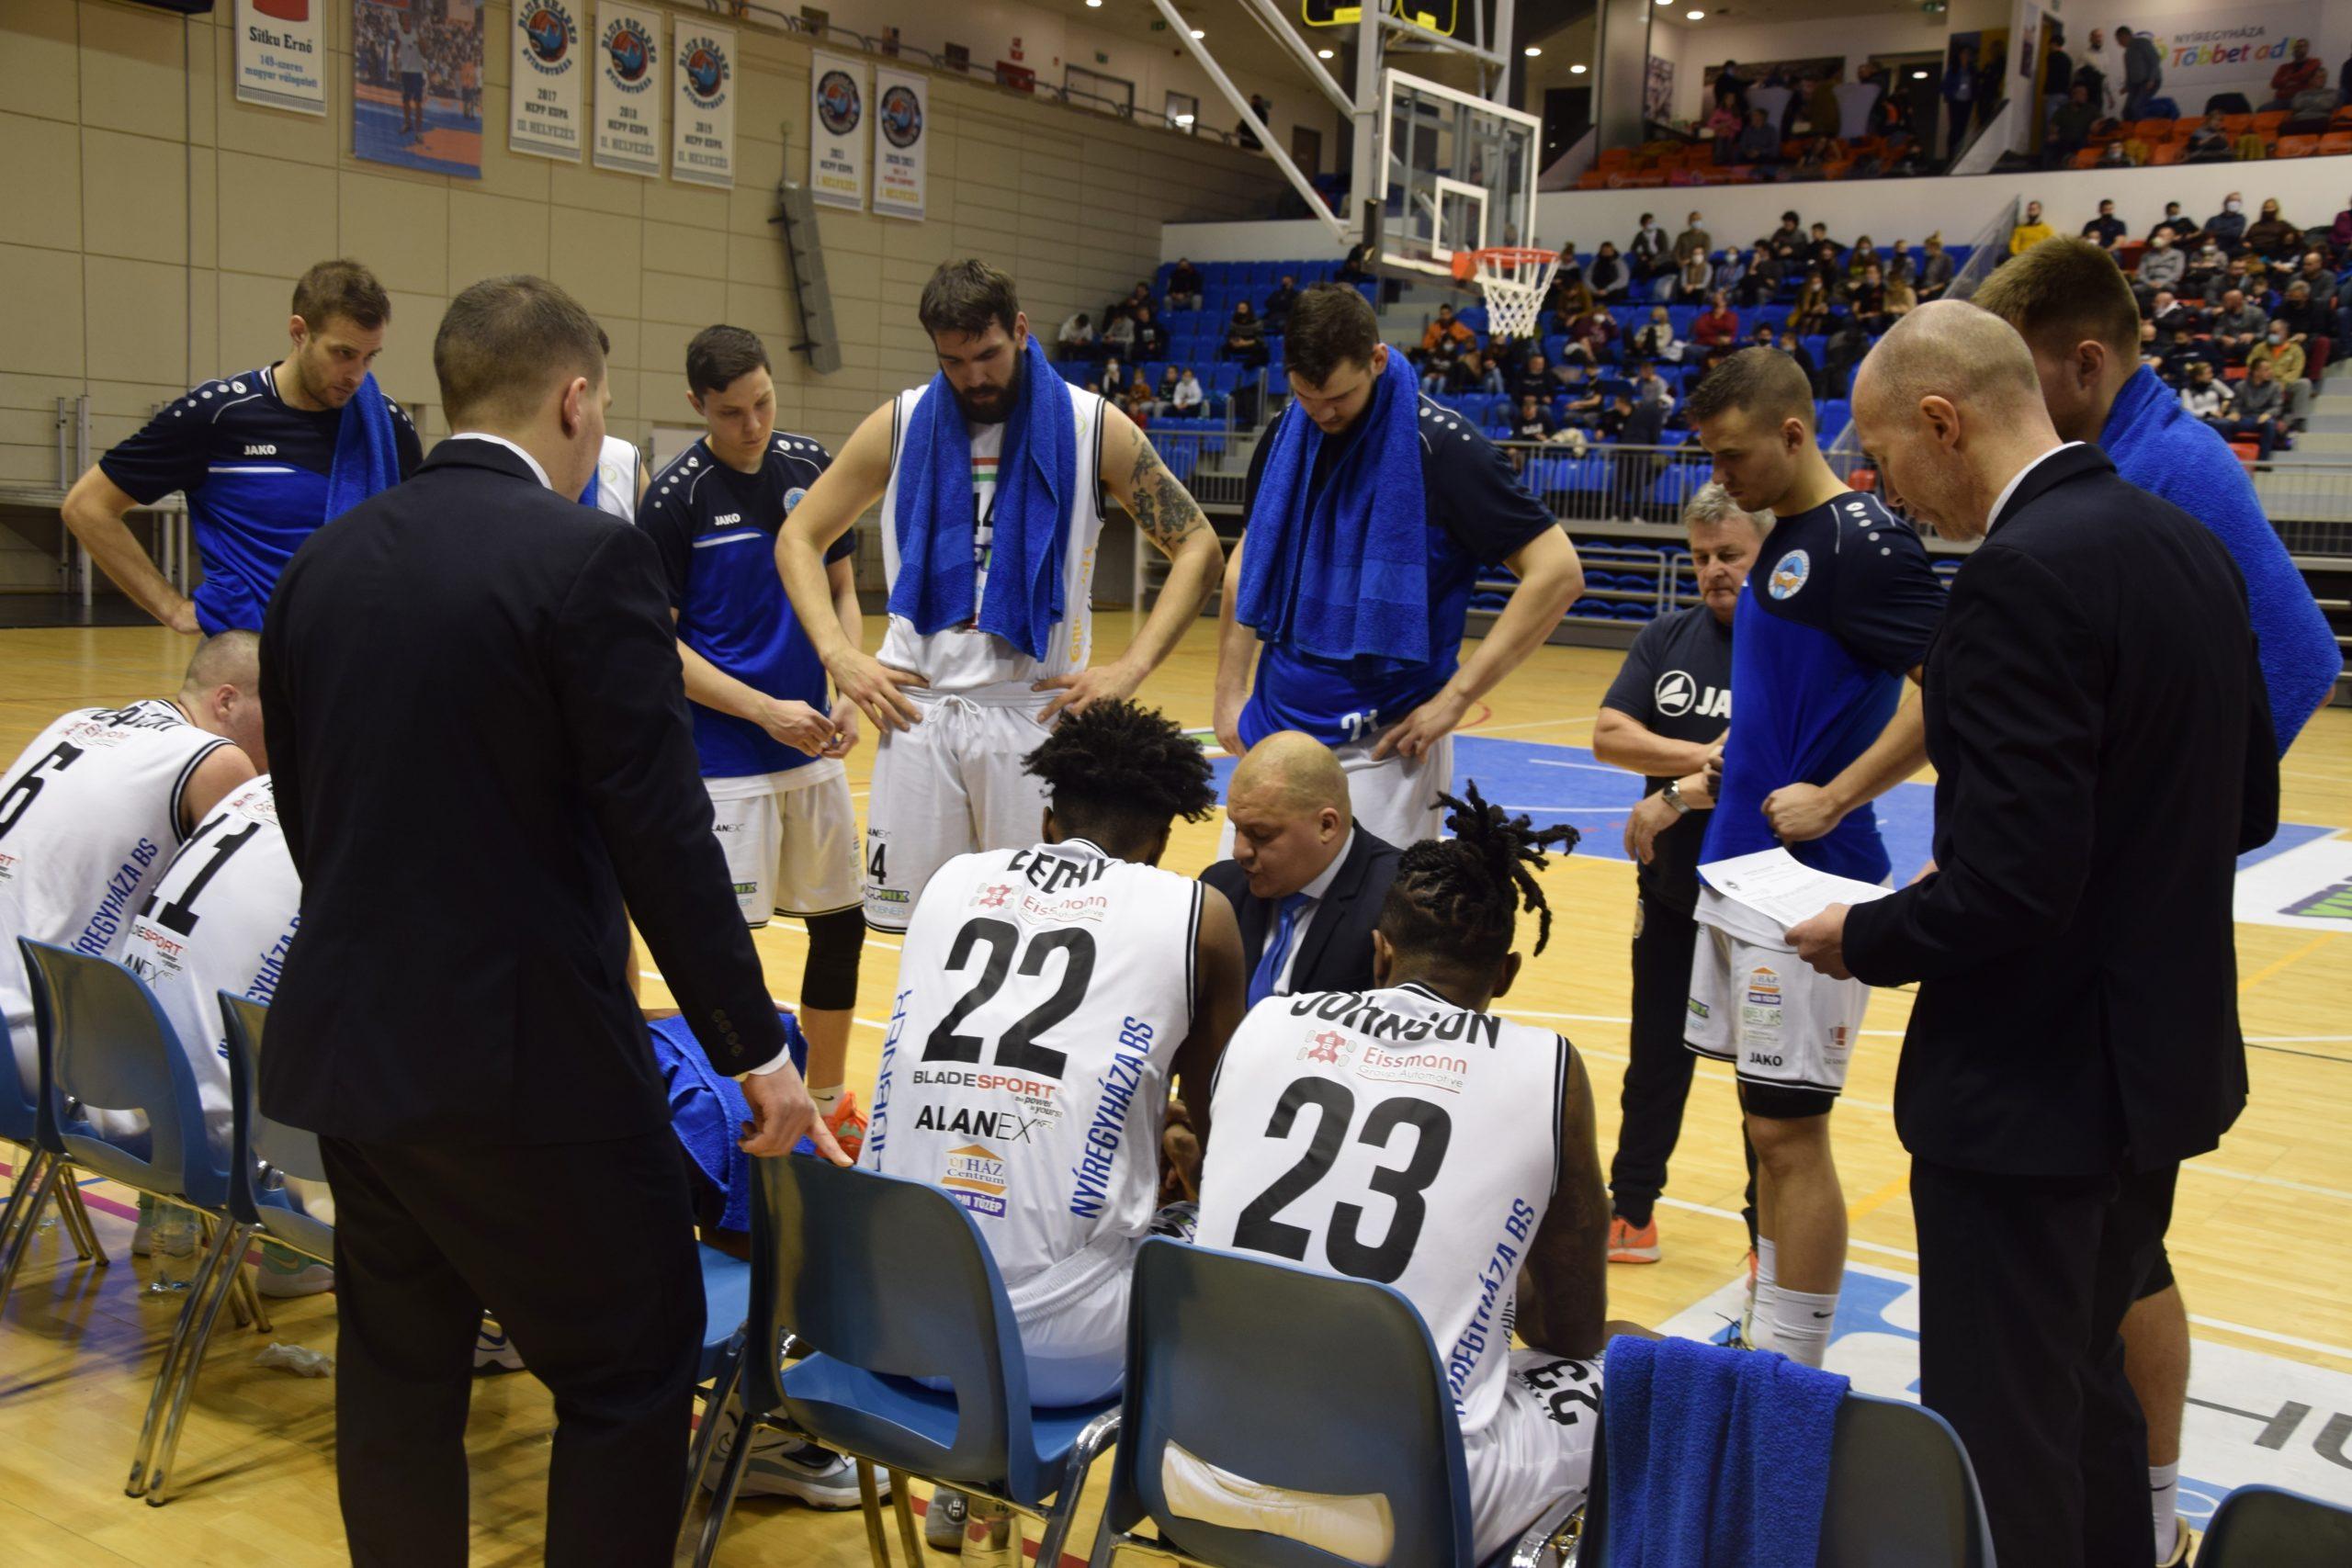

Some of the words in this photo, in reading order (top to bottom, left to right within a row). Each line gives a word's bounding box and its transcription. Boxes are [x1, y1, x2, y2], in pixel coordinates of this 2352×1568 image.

[249, 26, 280, 48] Sitku
[2174, 26, 2266, 43] NYÍREGYHÁZA
[2172, 43, 2251, 68] Többet
[243, 444, 277, 456] JAKO
[714, 513, 741, 526] JAKO
[0, 741, 84, 840] 6
[130, 837, 158, 868] BS
[922, 917, 1096, 1080] 22
[1363, 1045, 1468, 1075] Eissmann
[1749, 1052, 1783, 1066] JAKO
[912, 1070, 1057, 1099] BLADESPORT
[915, 1105, 1038, 1144] ALANEX
[1070, 1054, 1145, 1220] NYÍREGYHÁZA
[1118, 1015, 1155, 1055] BS
[946, 1168, 1005, 1185] Centrum
[966, 1158, 1003, 1177] HÁZ
[1232, 1076, 1453, 1285] 23
[1505, 1197, 1535, 1244] BS
